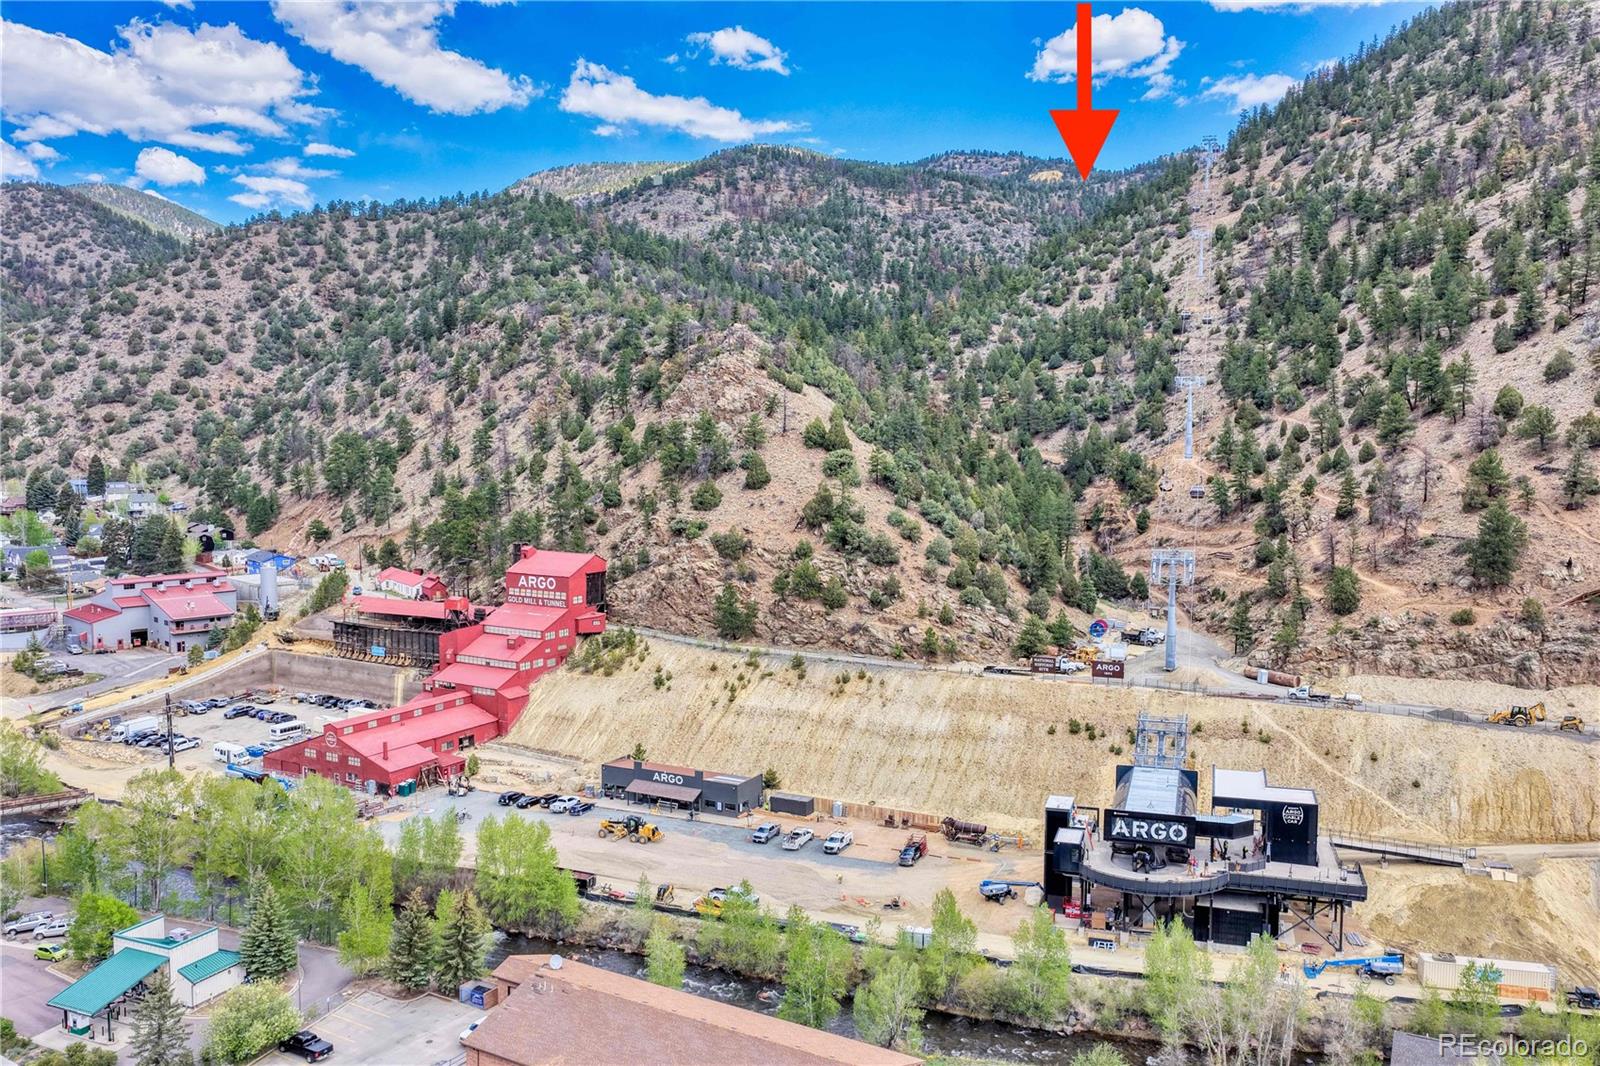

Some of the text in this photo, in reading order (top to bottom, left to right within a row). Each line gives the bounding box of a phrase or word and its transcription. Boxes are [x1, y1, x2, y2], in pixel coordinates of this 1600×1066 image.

[518, 575, 557, 590] ARGO
[507, 595, 523, 604] GOLD
[523, 597, 537, 605] MILL
[543, 599, 567, 608] TUNNEL
[1096, 663, 1121, 672] ARGO
[652, 772, 684, 785] ARGO
[1111, 818, 1188, 842] ARGO
